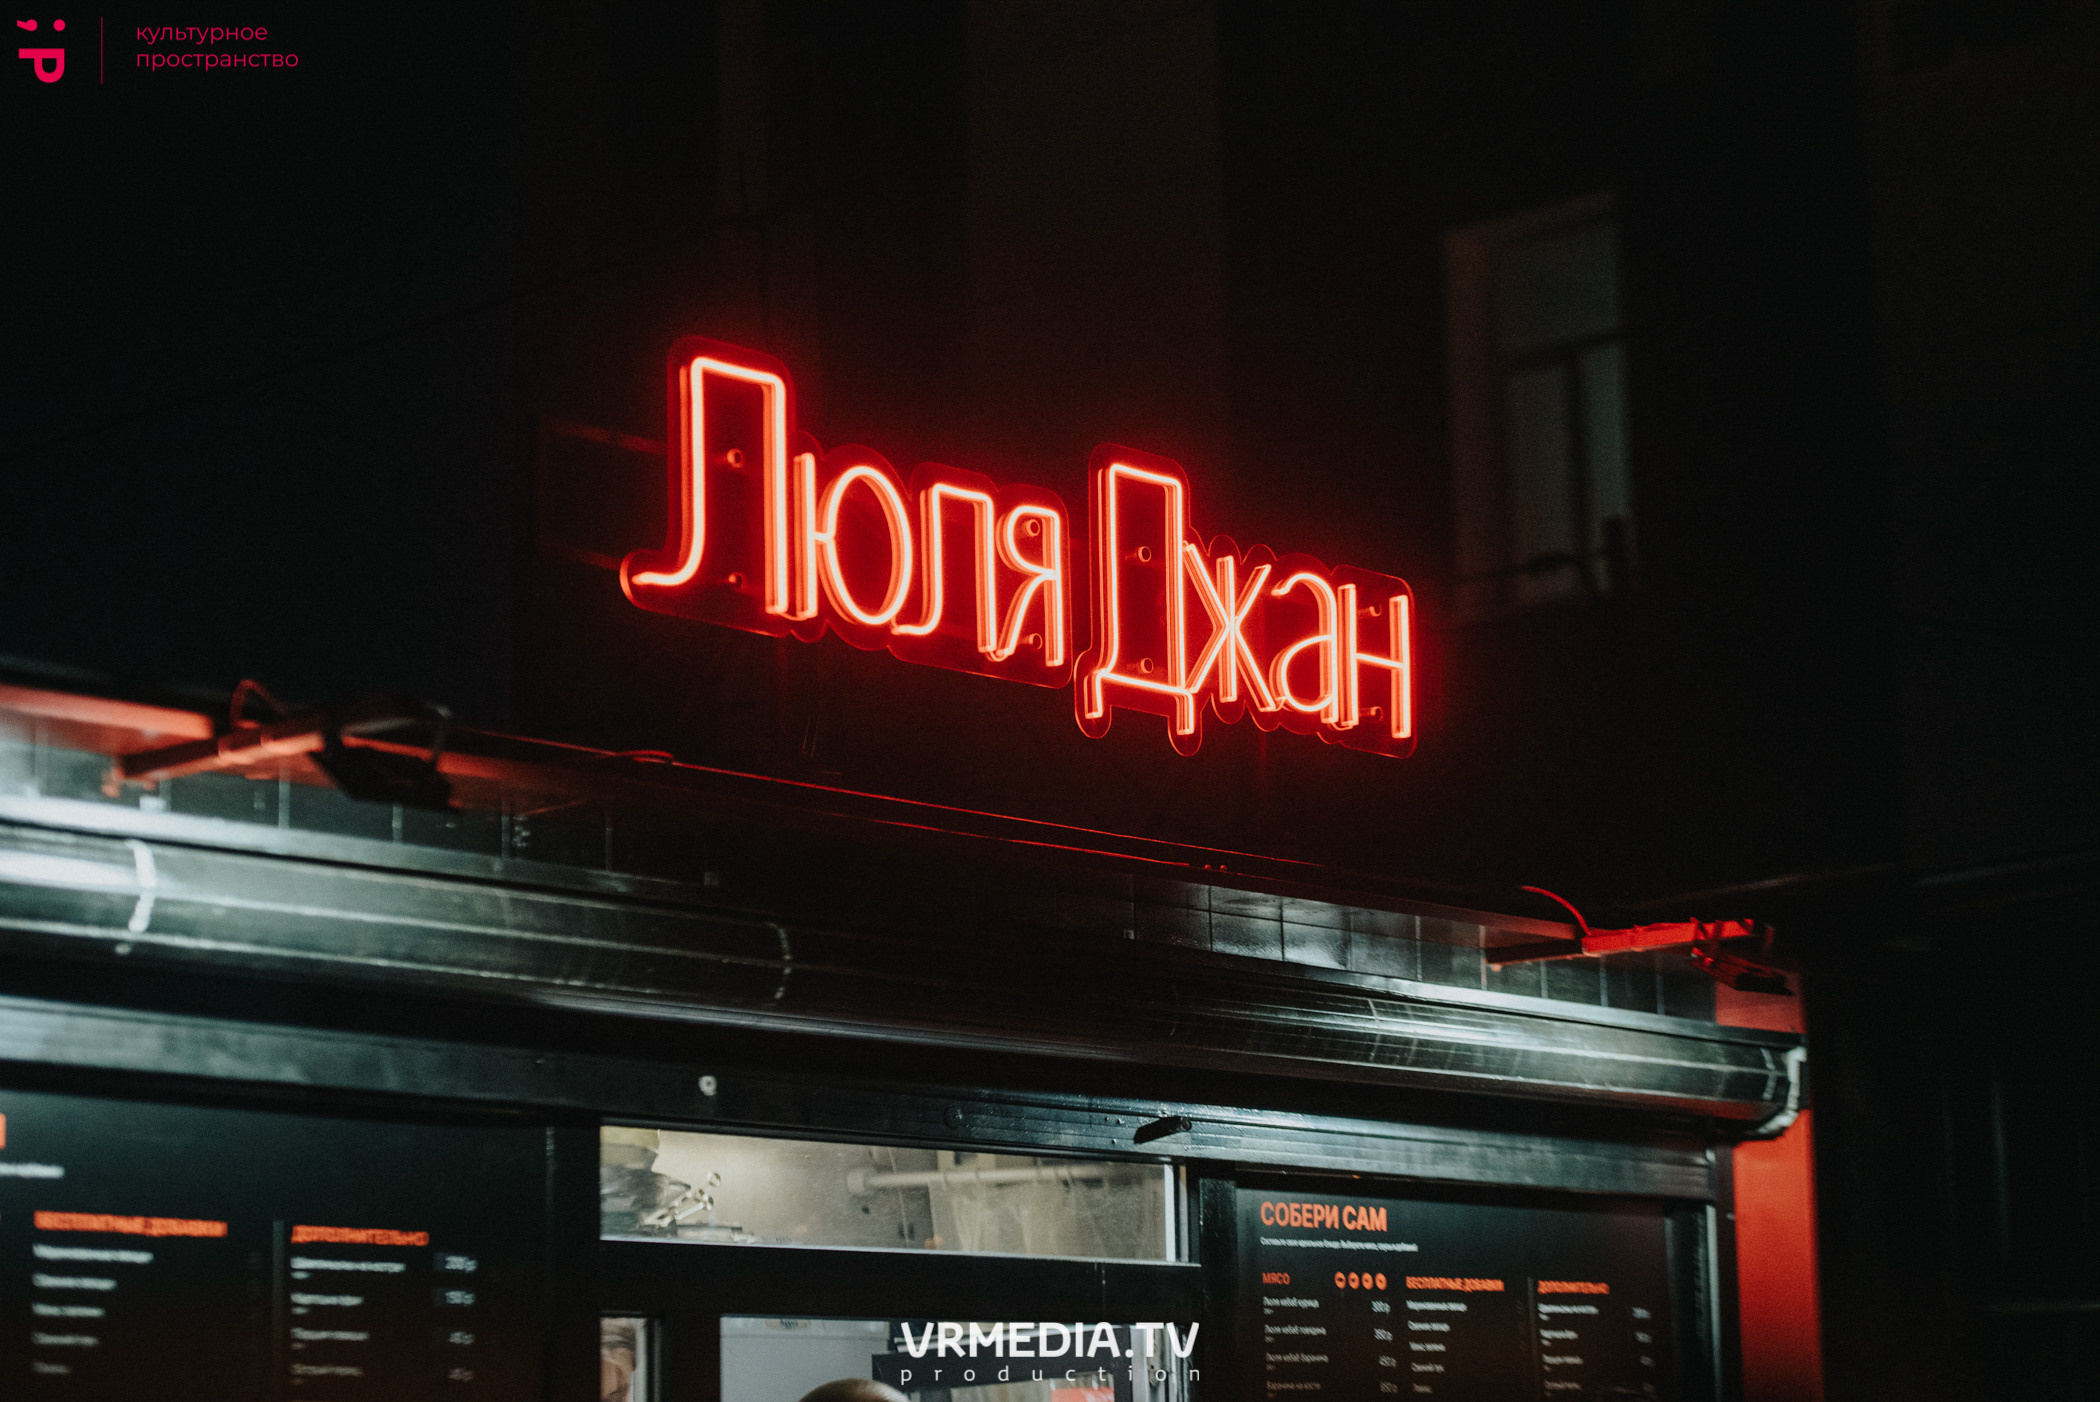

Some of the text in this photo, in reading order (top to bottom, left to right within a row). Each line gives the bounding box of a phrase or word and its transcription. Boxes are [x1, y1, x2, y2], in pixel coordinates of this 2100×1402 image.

[630, 355, 1412, 739] Люля Джан
[1260, 1201, 1388, 1232] СОБЕРИ САМ
[1262, 1272, 1291, 1286] МЯСО
